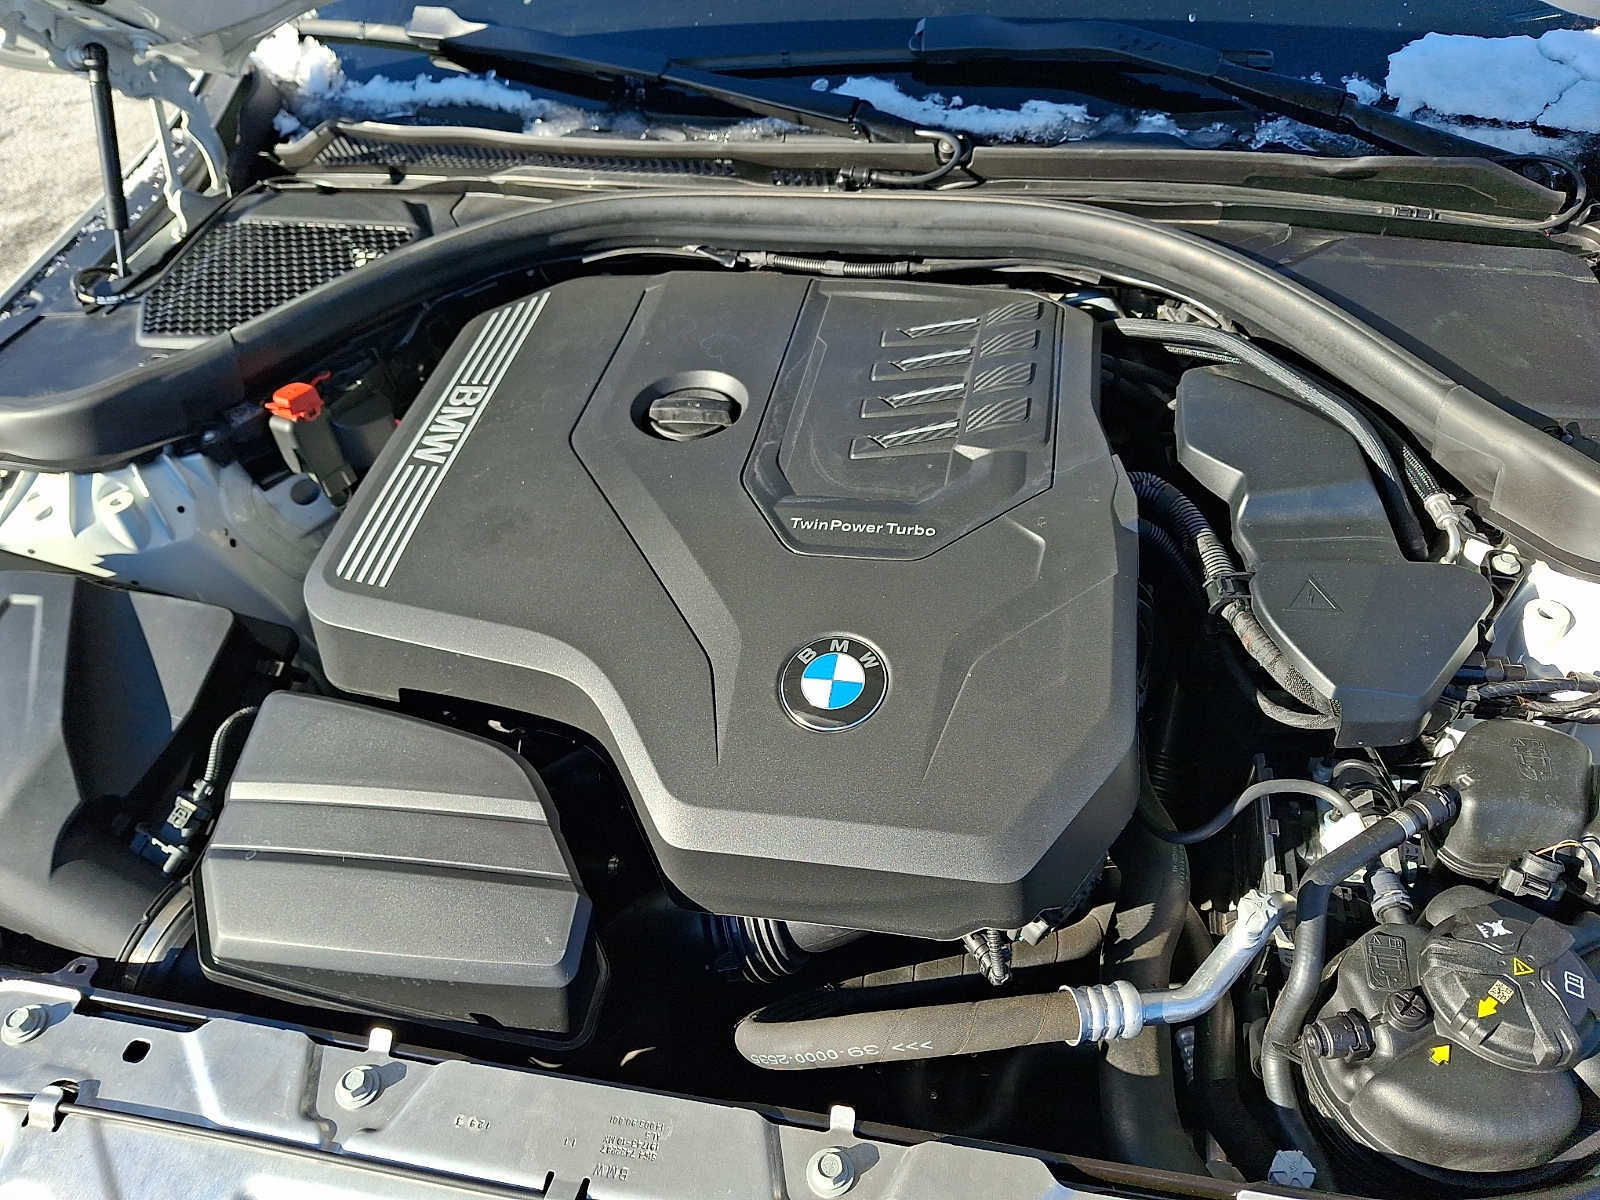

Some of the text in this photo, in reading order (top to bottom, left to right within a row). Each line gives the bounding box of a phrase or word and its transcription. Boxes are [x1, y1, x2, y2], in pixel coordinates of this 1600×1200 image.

[412, 385, 489, 464] BMW
[790, 517, 936, 537] TwinPower Turbo
[797, 639, 880, 669] BMW
[593, 1163, 629, 1180] BMW
